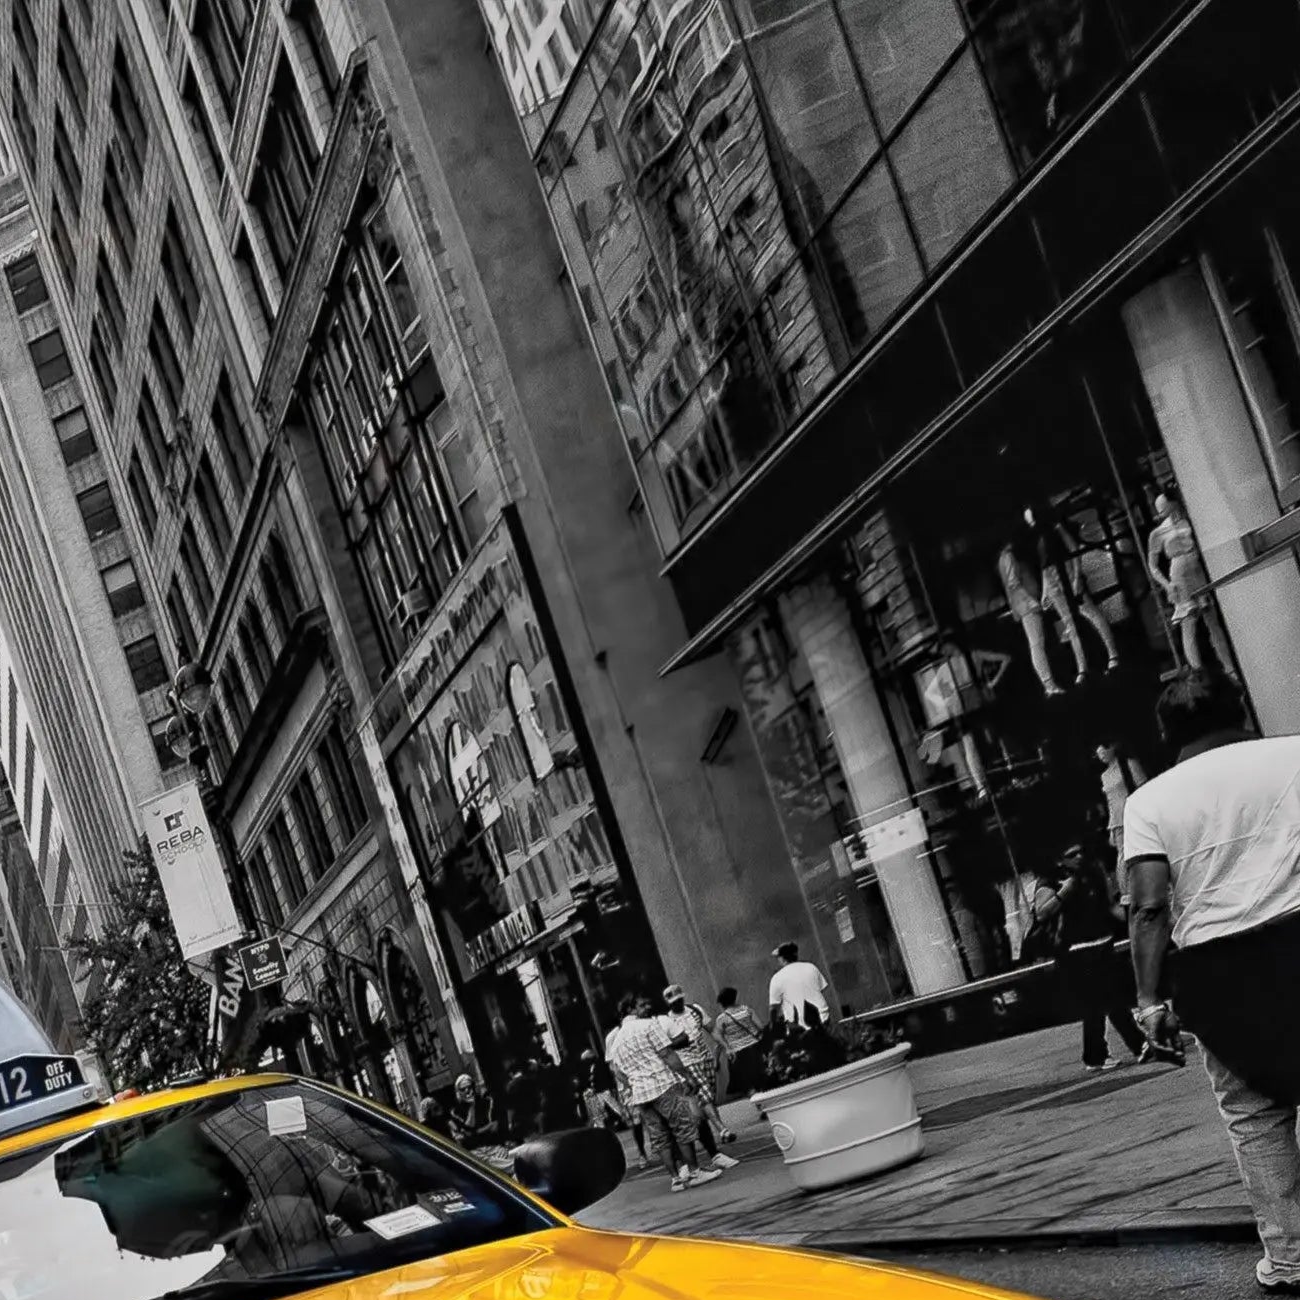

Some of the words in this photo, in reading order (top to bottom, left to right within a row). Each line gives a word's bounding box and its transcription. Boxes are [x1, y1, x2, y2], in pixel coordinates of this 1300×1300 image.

[156, 826, 204, 854] REBA
[46, 1060, 65, 1077] OFF
[44, 1071, 73, 1092] DUTY
